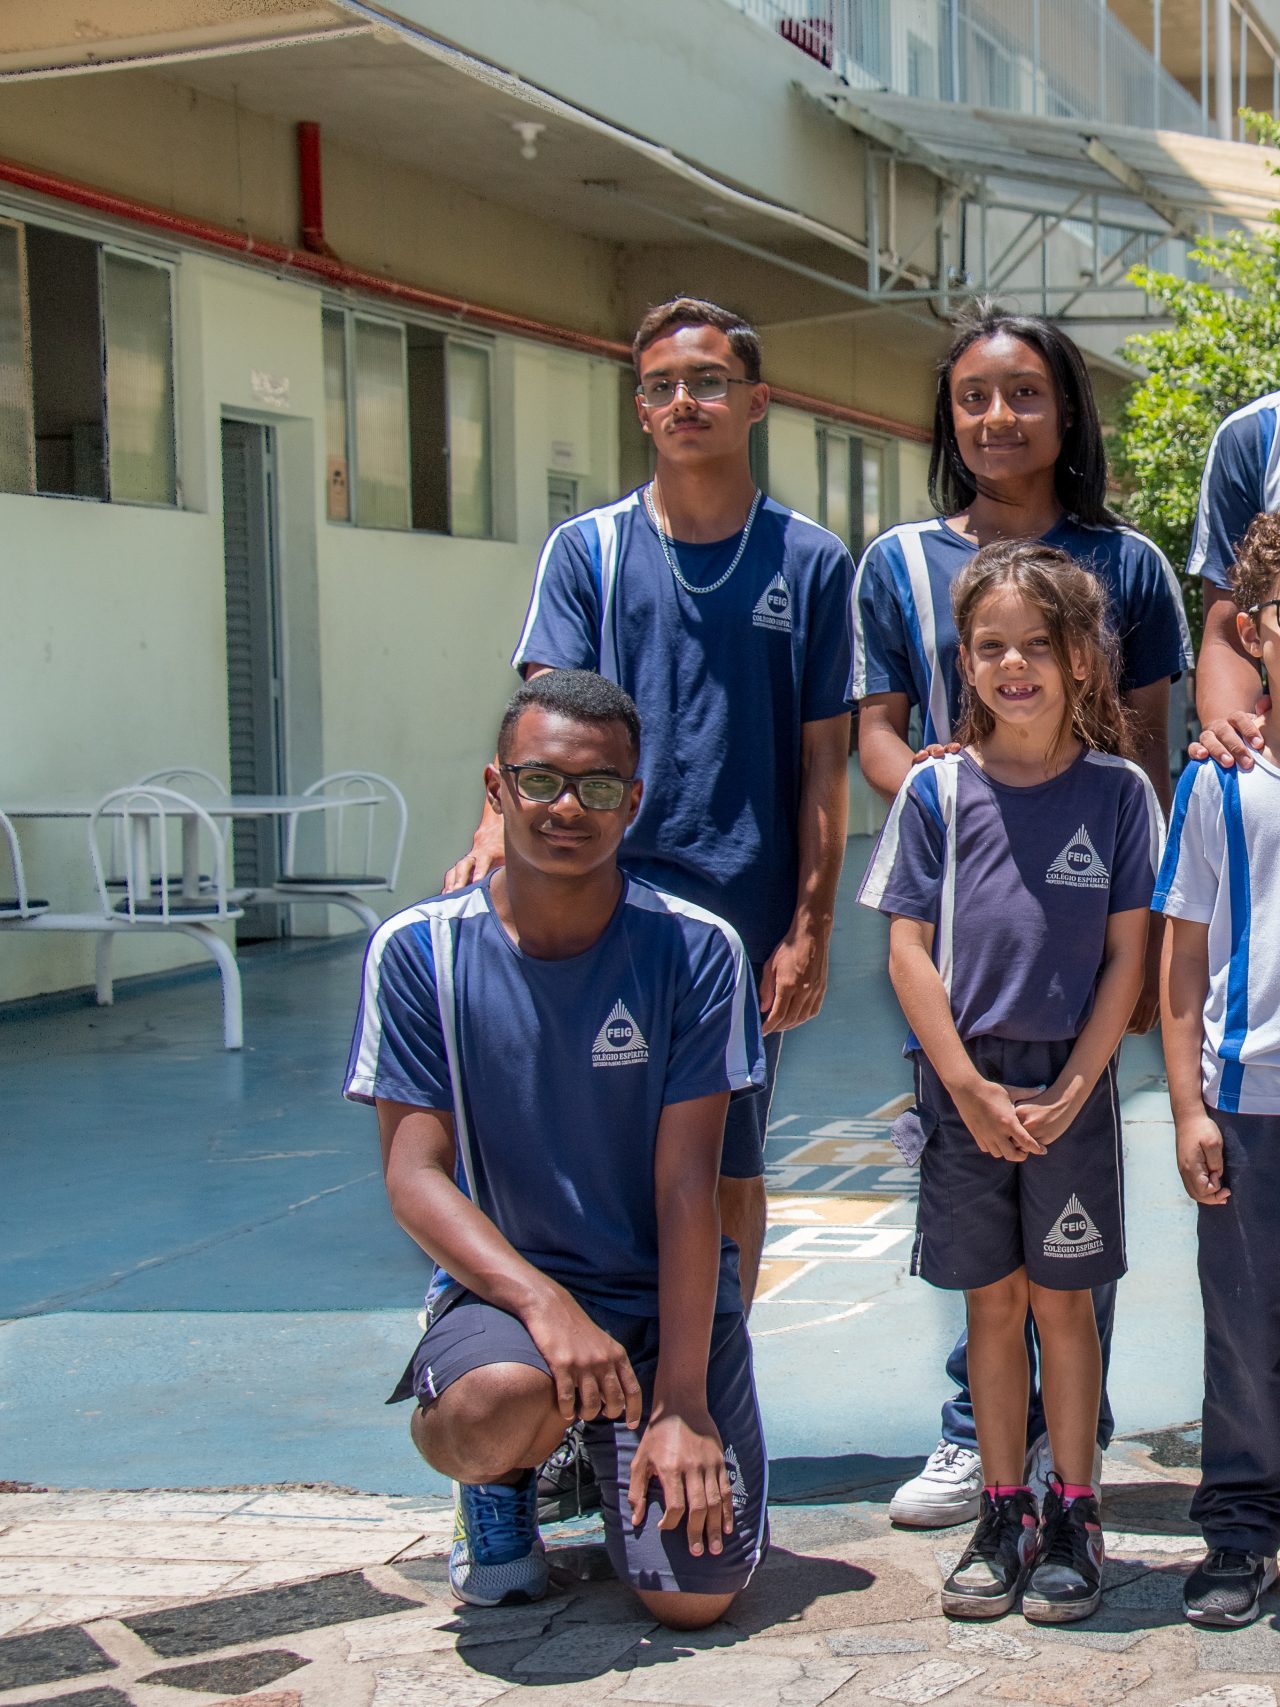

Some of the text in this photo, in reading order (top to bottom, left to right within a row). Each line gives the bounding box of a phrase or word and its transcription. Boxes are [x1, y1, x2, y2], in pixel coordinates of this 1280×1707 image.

[767, 594, 788, 607] FEIG
[1067, 851, 1091, 863] FEIG
[1045, 873, 1109, 884] COLÉGIO ESPÍRITA
[607, 1027, 632, 1039] FEIG
[619, 1050, 649, 1060] ESPÍRITA
[1061, 1220, 1087, 1232] FEIG
[1043, 1240, 1104, 1253] COLÉGIO ESPÍRITA
